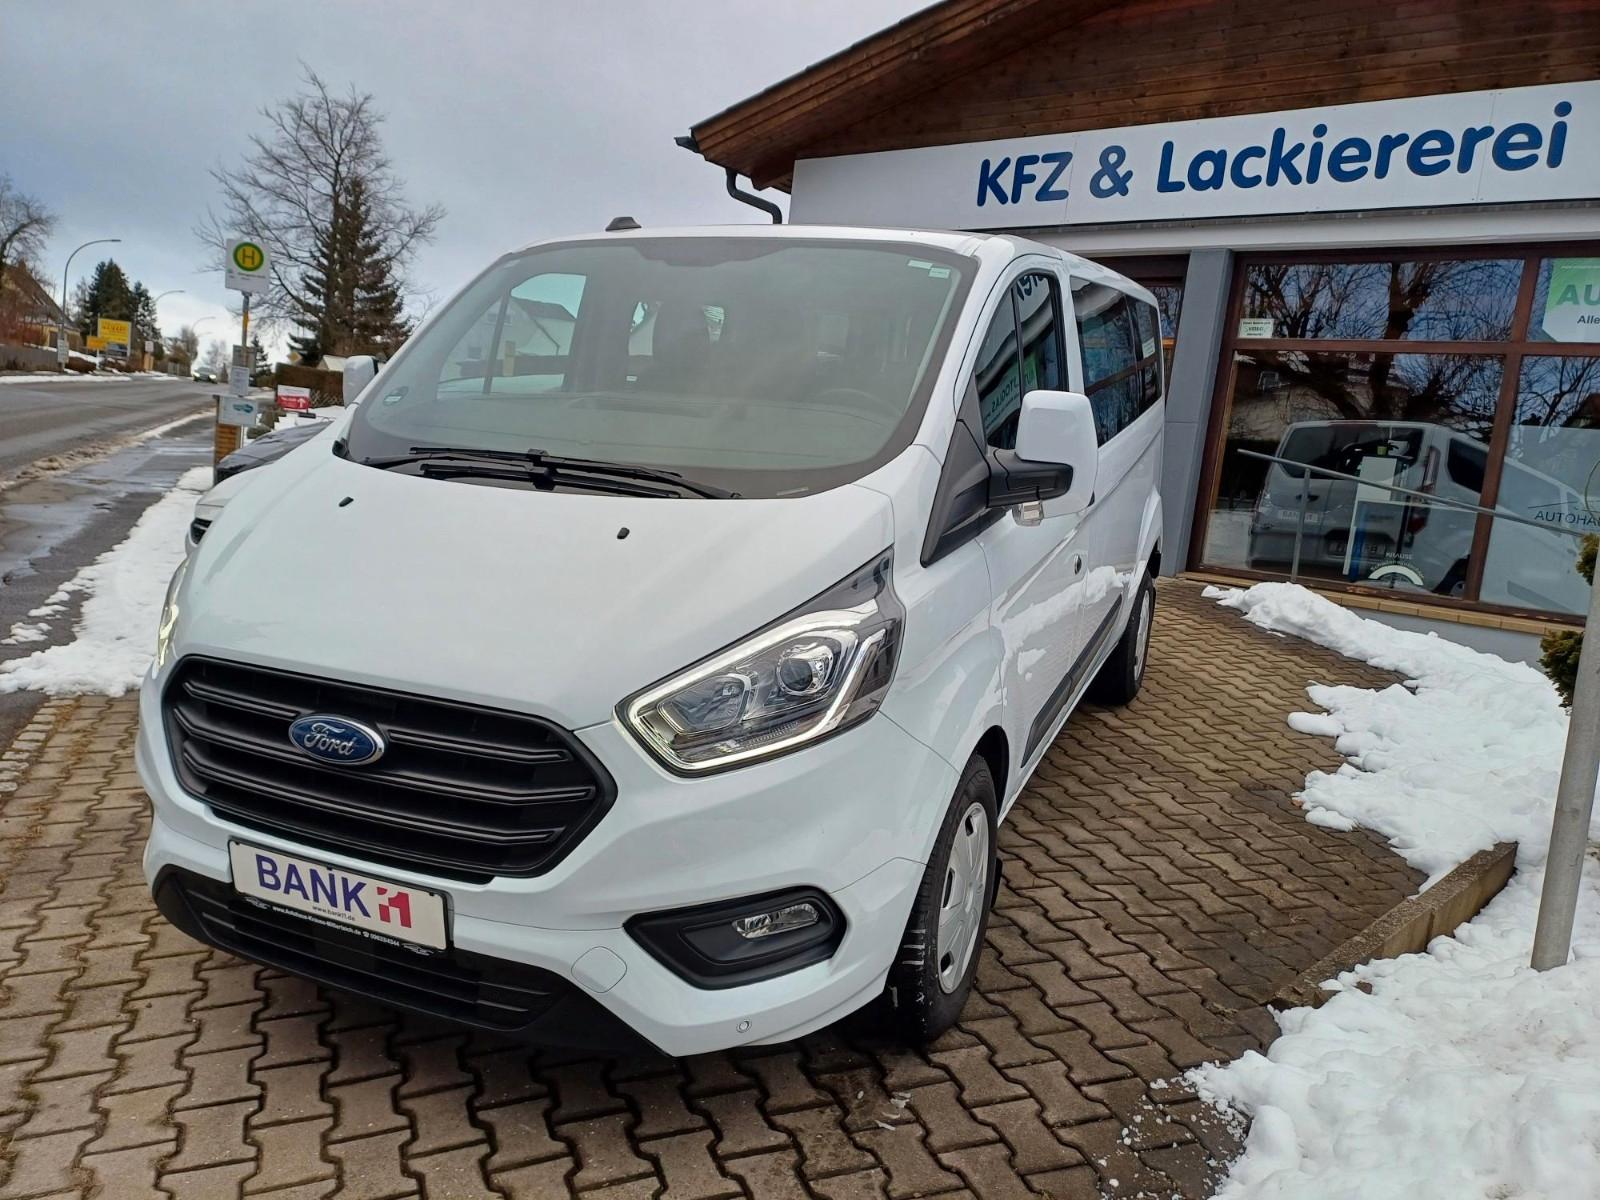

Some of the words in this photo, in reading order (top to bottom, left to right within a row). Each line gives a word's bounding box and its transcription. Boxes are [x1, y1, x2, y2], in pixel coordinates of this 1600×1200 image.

[976, 151, 1073, 207] KFZ
[1089, 144, 1133, 199] &
[1156, 100, 1573, 193] Lackiererei
[1534, 510, 1600, 527] AUTOHA
[303, 722, 358, 756] Ford
